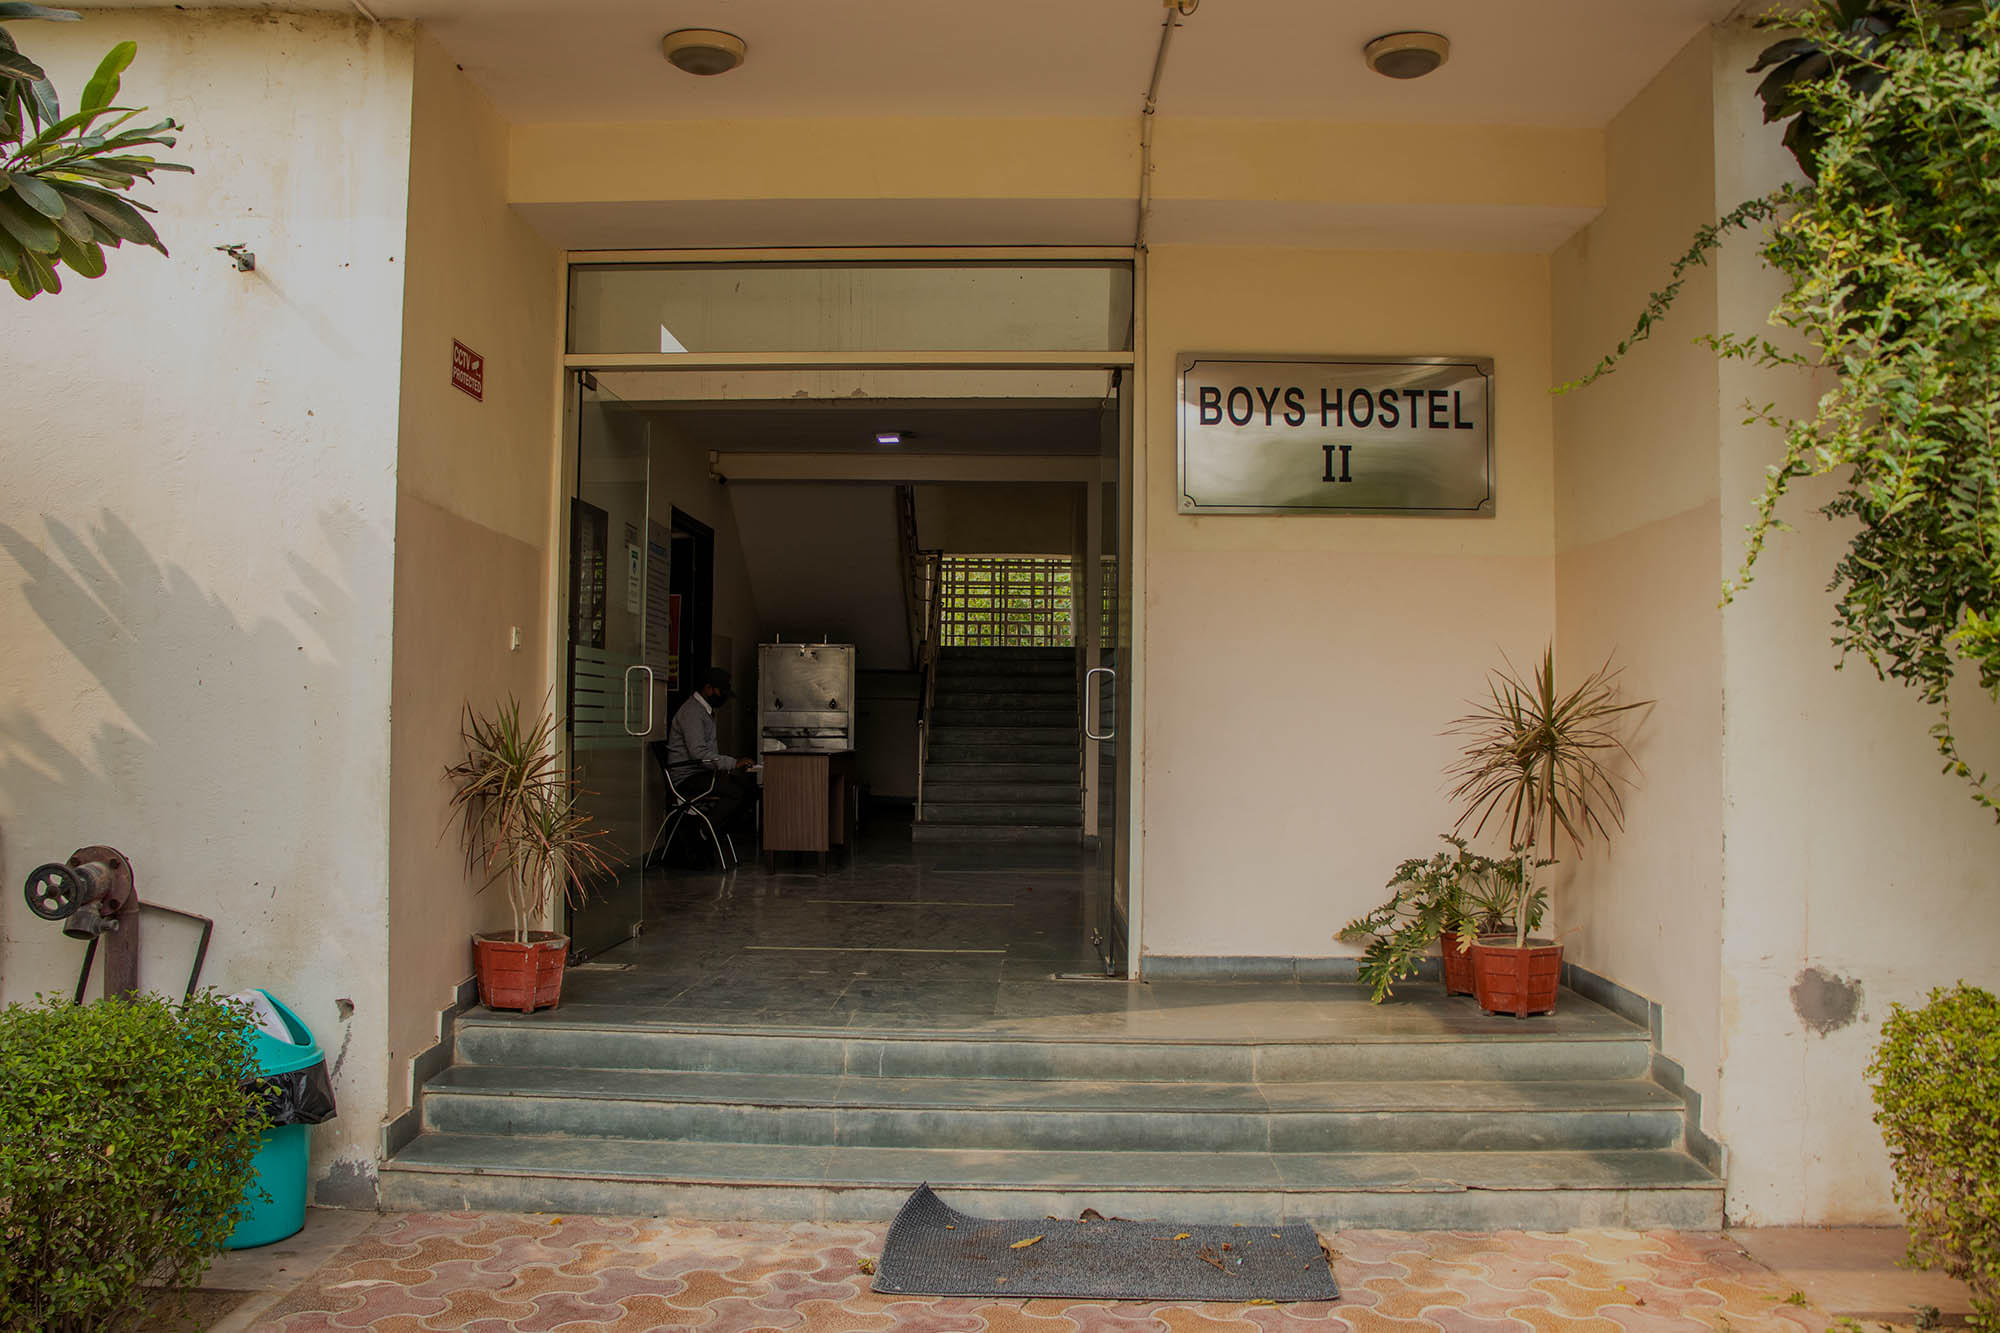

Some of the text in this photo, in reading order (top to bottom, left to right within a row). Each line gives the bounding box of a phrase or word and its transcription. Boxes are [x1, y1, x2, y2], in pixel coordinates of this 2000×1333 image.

[454, 345, 471, 370] CCTV
[453, 366, 482, 393] PROTECTED
[1199, 386, 1474, 430] BOYS HOSTEL
[1322, 444, 1353, 483] II
